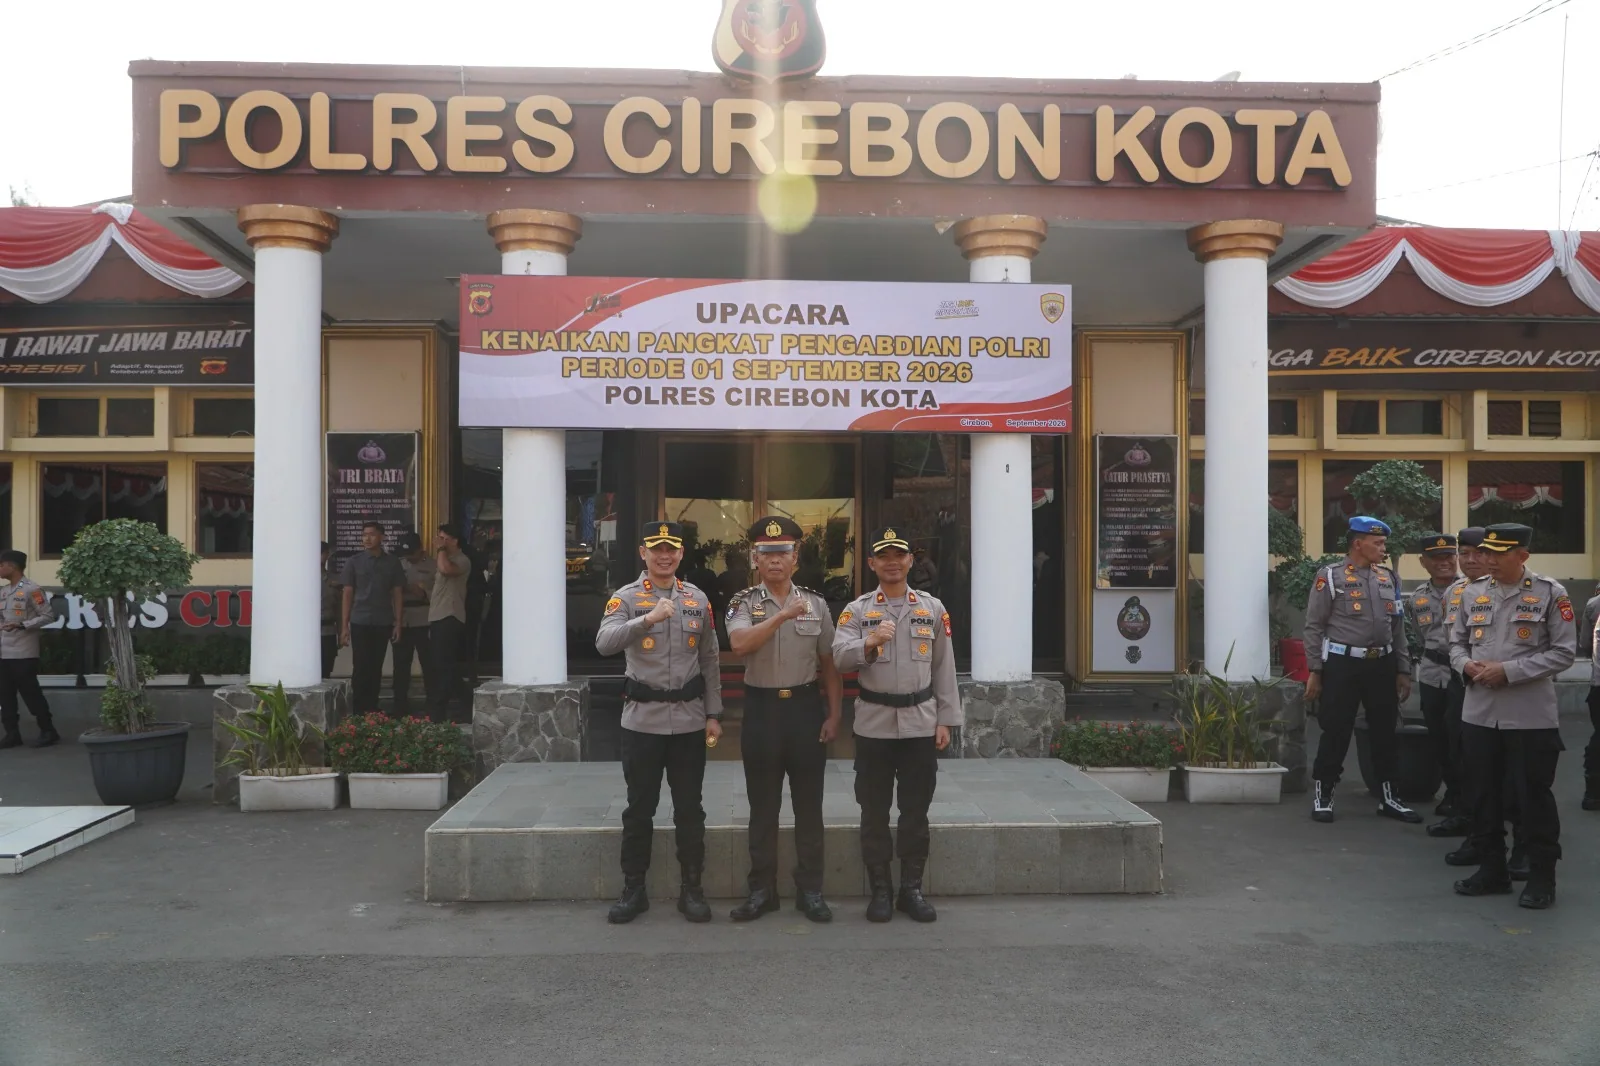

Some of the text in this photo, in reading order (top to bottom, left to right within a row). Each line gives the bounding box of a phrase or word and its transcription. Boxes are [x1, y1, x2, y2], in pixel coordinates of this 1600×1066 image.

[159, 89, 1352, 187] POLRES CIREBON KOTA
[696, 302, 850, 326] UPACARA
[12, 333, 99, 358] RAWAT
[98, 331, 166, 354] JAWA
[172, 329, 252, 351] BARAT
[480, 330, 1050, 359] KENAIKAN PANGKAT PENGABDIAN POLRI
[1319, 347, 1412, 367] BAIK
[1413, 349, 1544, 367] CIREBON
[561, 356, 973, 384] PERIODE 01 SEPTEMBER 2026
[605, 385, 940, 410] POLRES CIREBON KOTA
[960, 418, 1067, 429] Cirebon, September 2026
[338, 468, 405, 483] TRI BRATA
[1131, 471, 1171, 483] PRASETYA
[682, 609, 702, 617] POLRI
[1470, 605, 1493, 613] DIDIN
[1515, 605, 1542, 613] POLRI
[910, 617, 934, 626] POLRI
